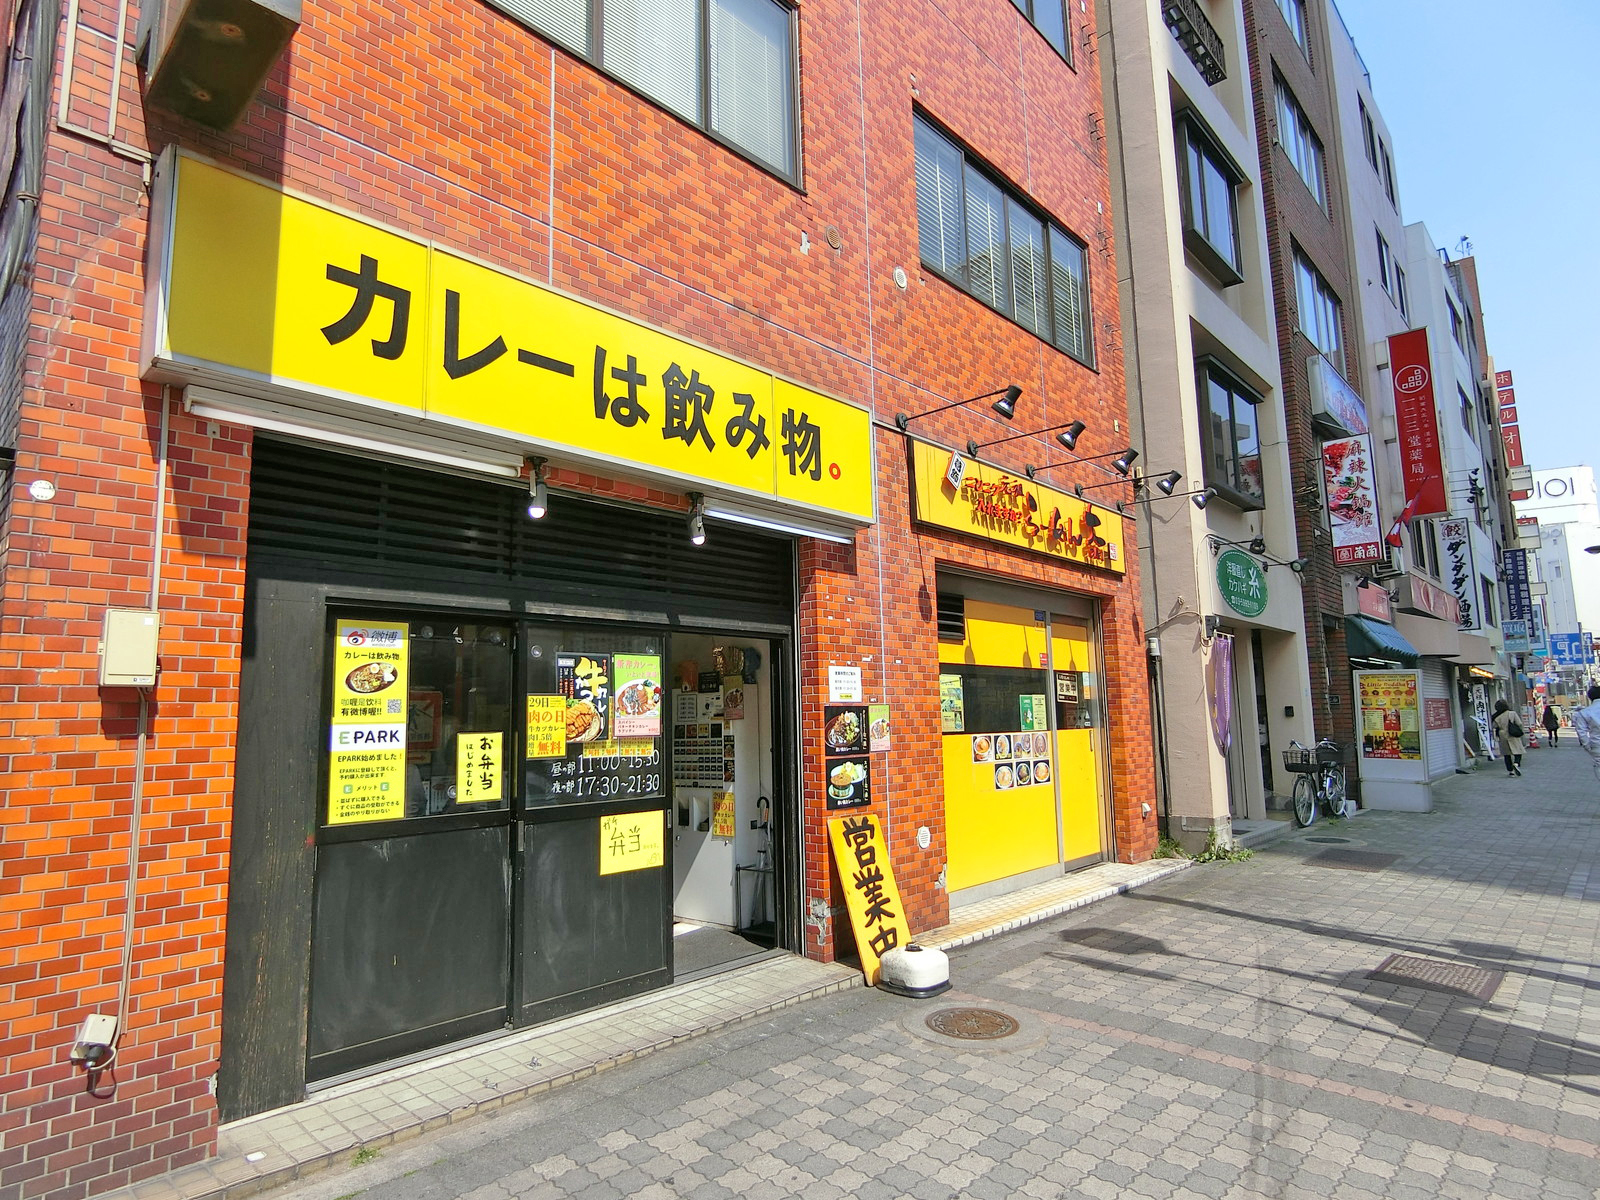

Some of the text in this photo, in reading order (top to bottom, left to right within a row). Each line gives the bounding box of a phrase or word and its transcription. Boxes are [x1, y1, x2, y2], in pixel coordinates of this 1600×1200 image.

[320, 253, 842, 484] カレーは飲み物。
[1401, 397, 1424, 474] 一二三堂薬局
[1248, 566, 1261, 599] 糸
[529, 697, 549, 708] 29日
[529, 710, 564, 723] 肉の日
[339, 730, 400, 744] EPARK
[538, 741, 562, 755] 無料
[465, 744, 474, 796] はじめました
[478, 737, 495, 790] お弁当
[608, 826, 641, 857] 弁当
[842, 815, 899, 959] 営業中
